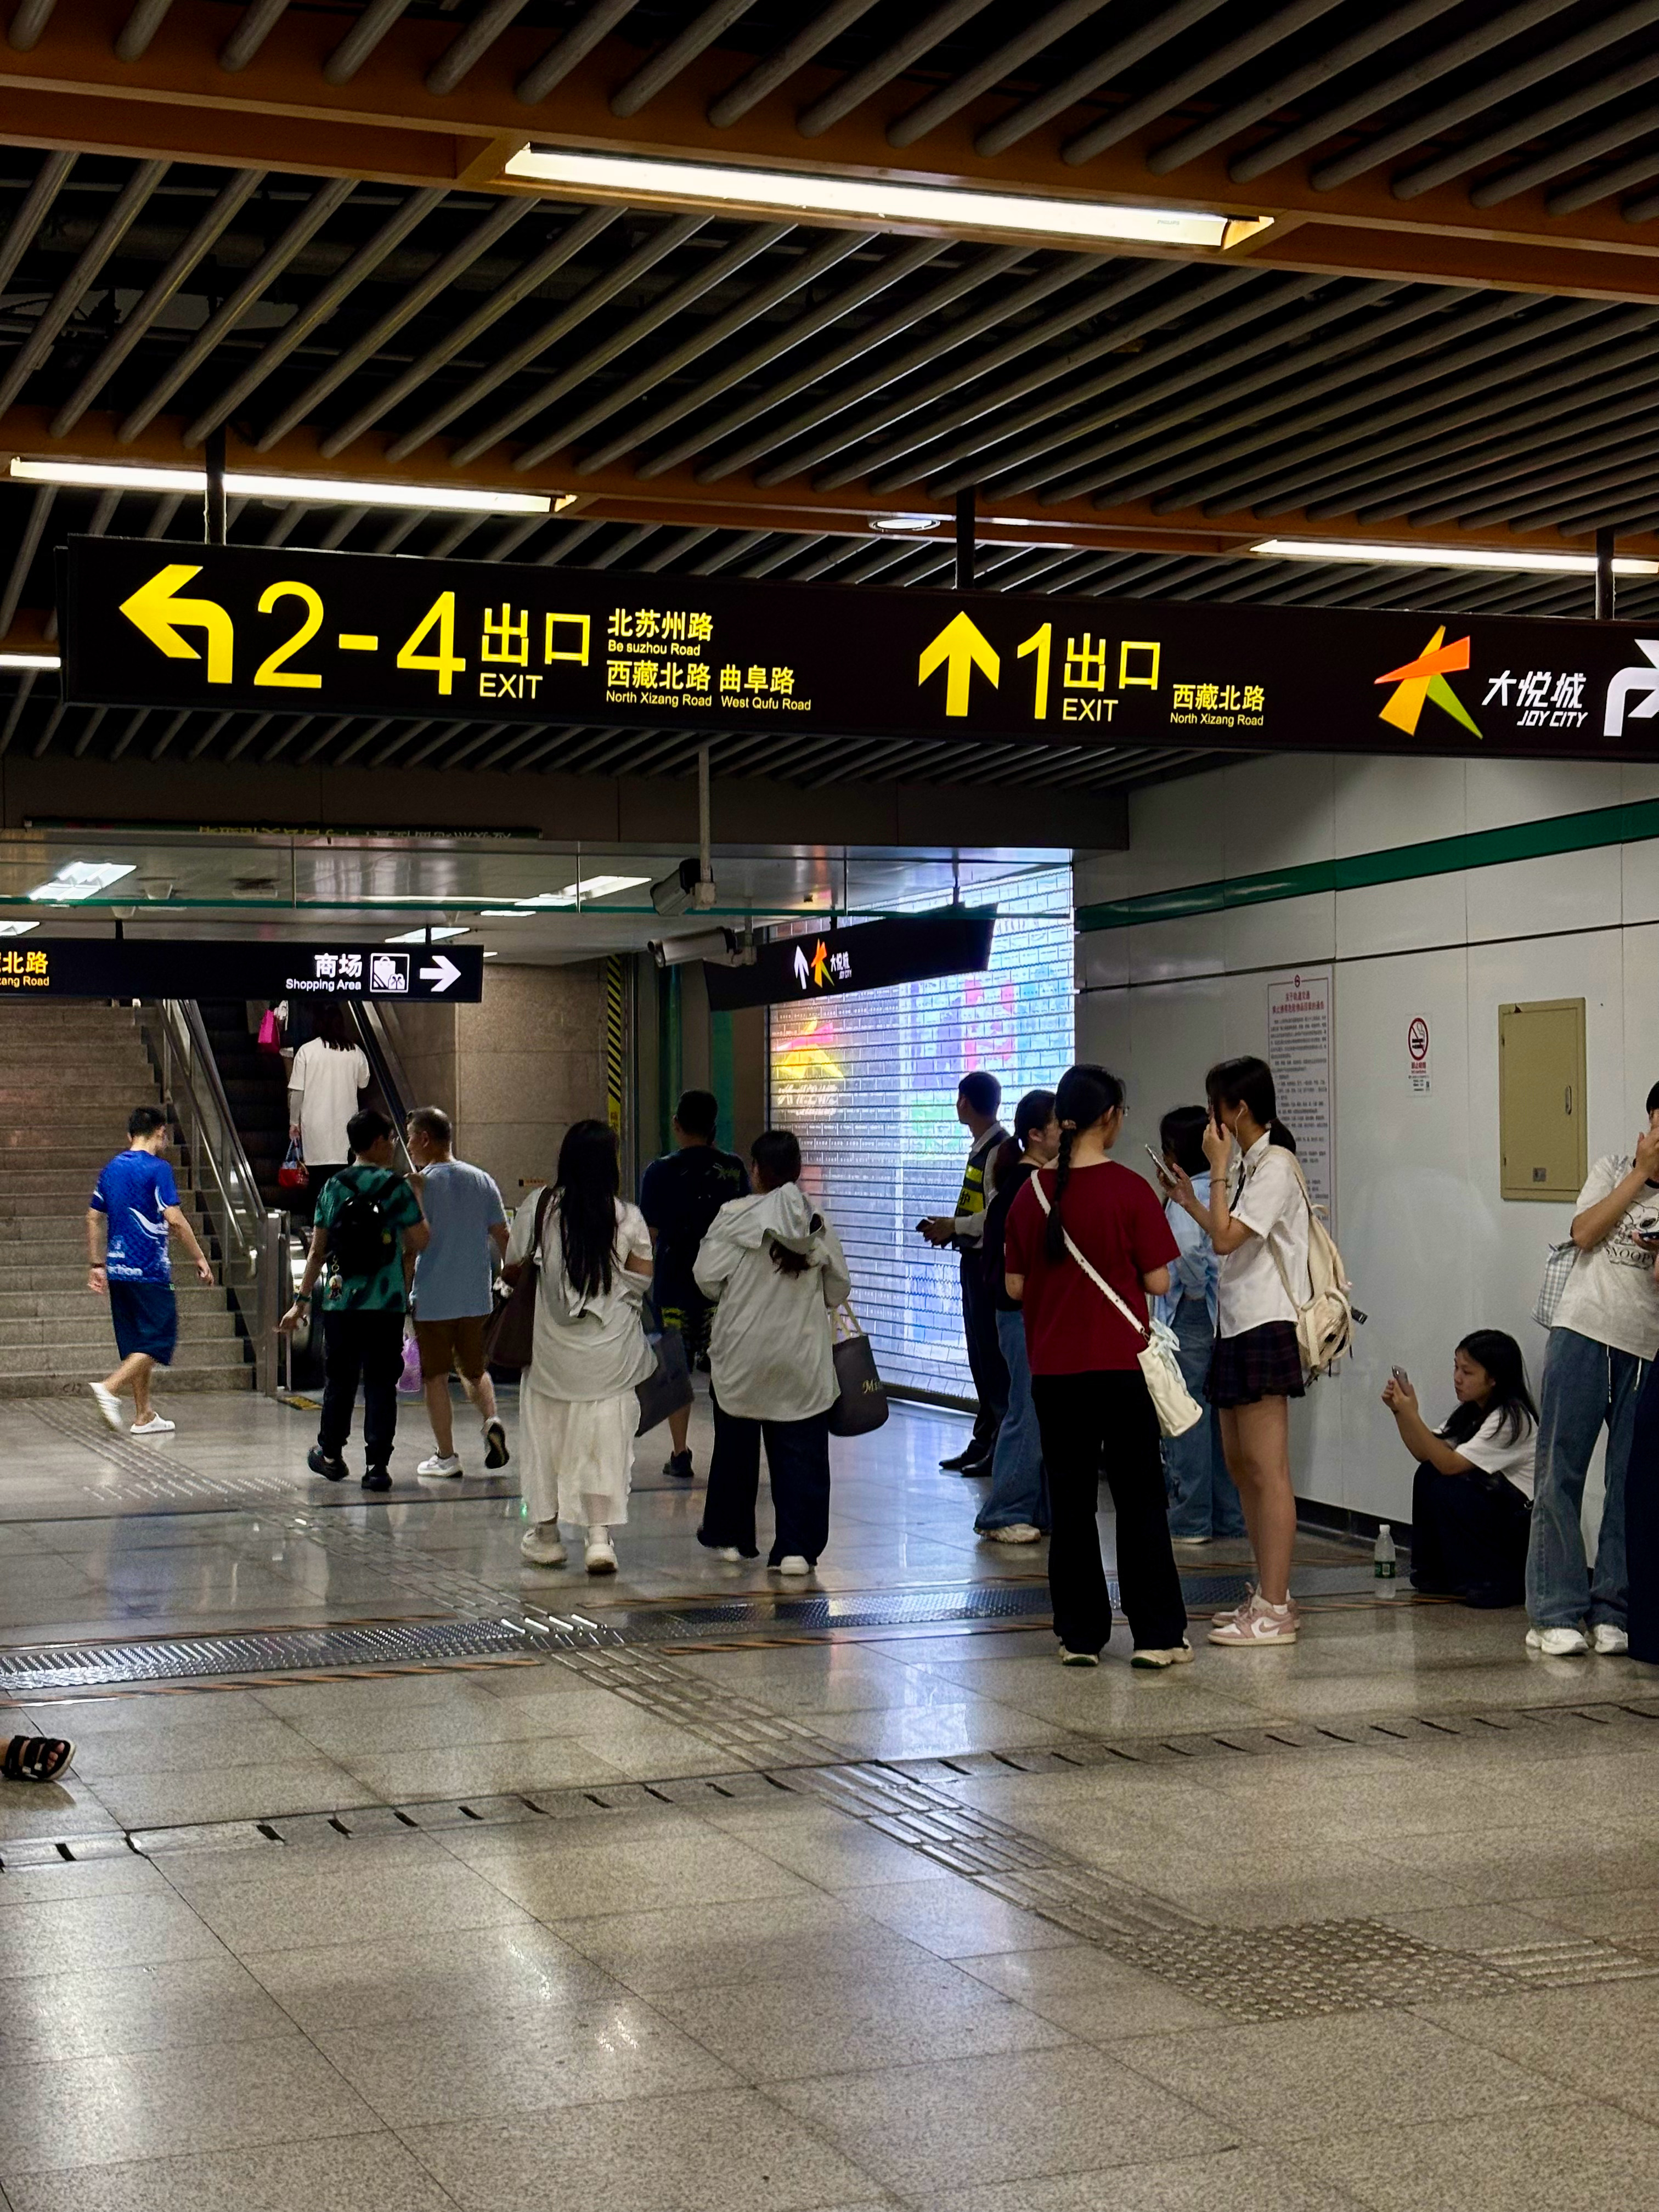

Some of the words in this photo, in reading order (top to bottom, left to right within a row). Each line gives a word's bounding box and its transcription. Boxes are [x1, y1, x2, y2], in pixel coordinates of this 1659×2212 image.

[607, 608, 713, 642] 北苏州路
[254, 581, 466, 695] 2-4
[481, 603, 590, 667] 出口
[627, 641, 667, 655] suzhou
[670, 642, 701, 656] Road
[606, 659, 711, 691] 西藏北路
[720, 664, 795, 695] 曲阜路
[1017, 623, 1052, 719] 1
[1064, 633, 1160, 692] 出口
[479, 673, 543, 699] EXIT
[1173, 683, 1265, 712] 西藏北路
[1482, 670, 1587, 709] 大悦城
[606, 690, 637, 703] North
[640, 692, 679, 708] Xizang
[682, 693, 712, 707] Road
[721, 695, 749, 708] West
[752, 697, 778, 709] Qufu
[782, 698, 811, 710] Road
[1063, 698, 1119, 722] EXIT
[1170, 712, 1198, 724] North
[1200, 713, 1234, 727] Xizang
[1237, 714, 1264, 726] Road
[1516, 710, 1550, 726] JOY
[1549, 712, 1588, 728] CITY
[0, 951, 48, 974] 北路
[314, 953, 362, 978] 商场
[0, 977, 20, 988] ang
[23, 975, 49, 986] Road
[285, 978, 335, 992] Shopping
[337, 979, 362, 990] Area
